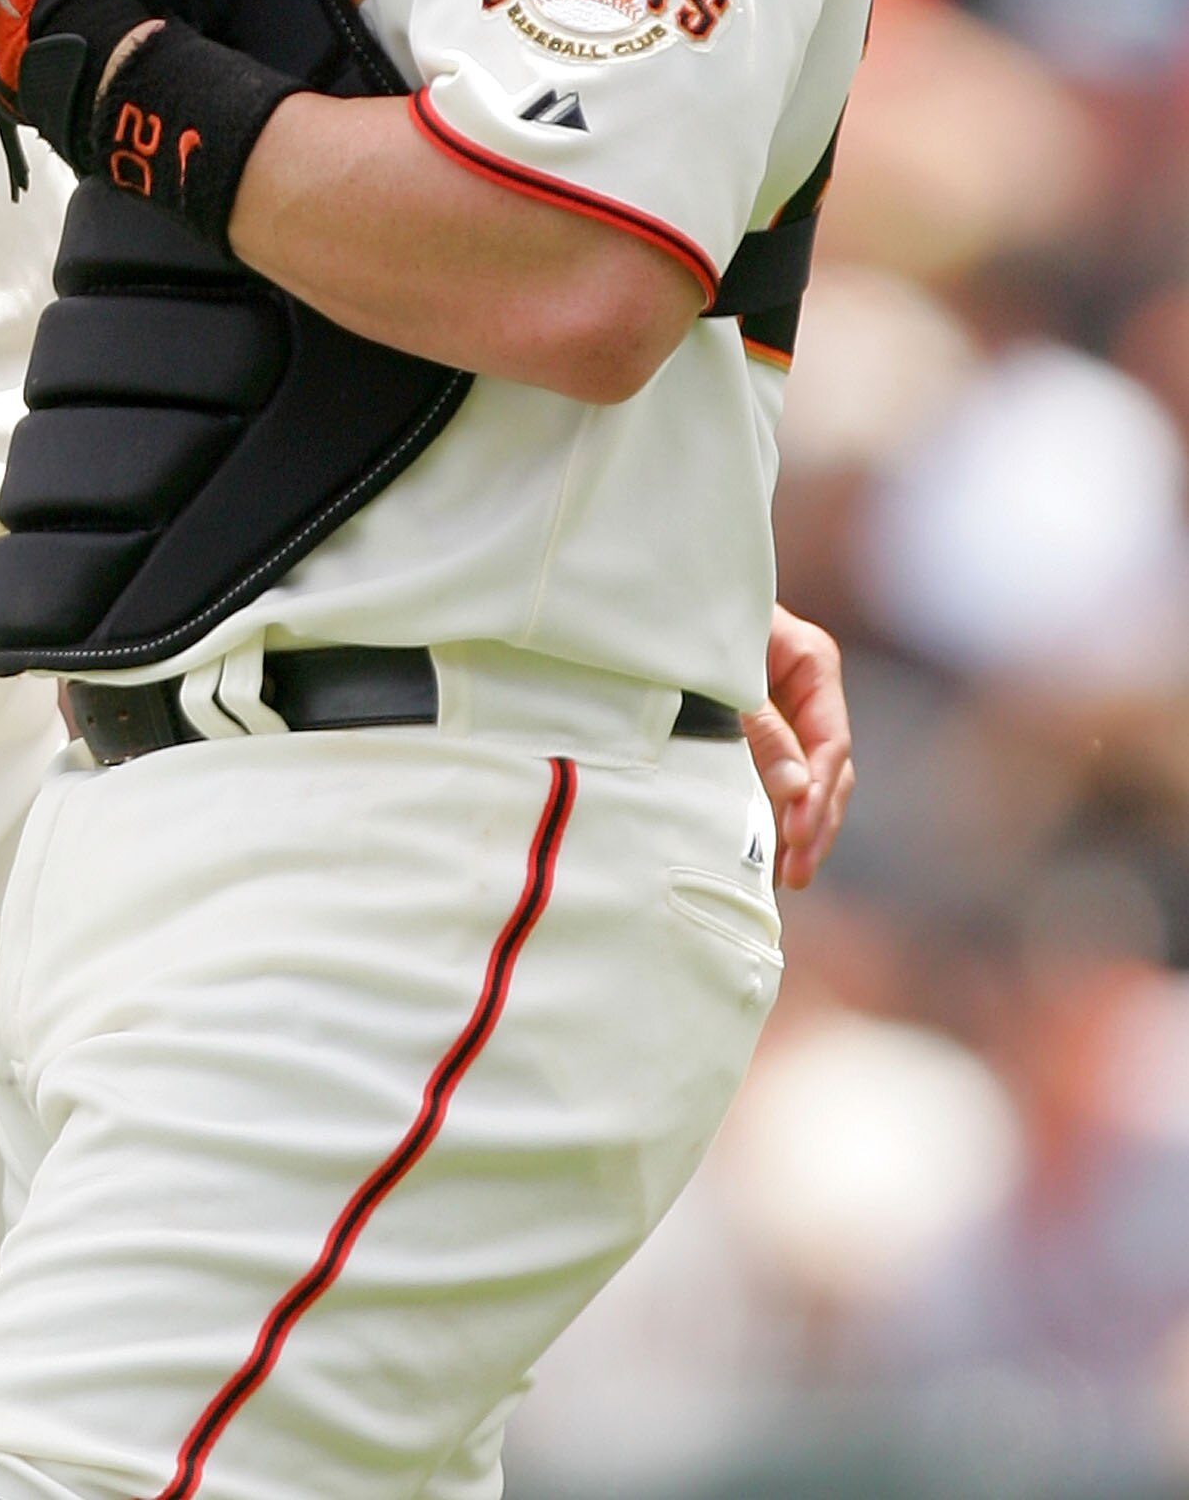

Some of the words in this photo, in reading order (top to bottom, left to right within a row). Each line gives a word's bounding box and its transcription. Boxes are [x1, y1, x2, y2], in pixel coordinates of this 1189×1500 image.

[506, 2, 608, 59] BASEBALL
[612, 23, 668, 57] CLUB
[110, 101, 162, 197] 20
